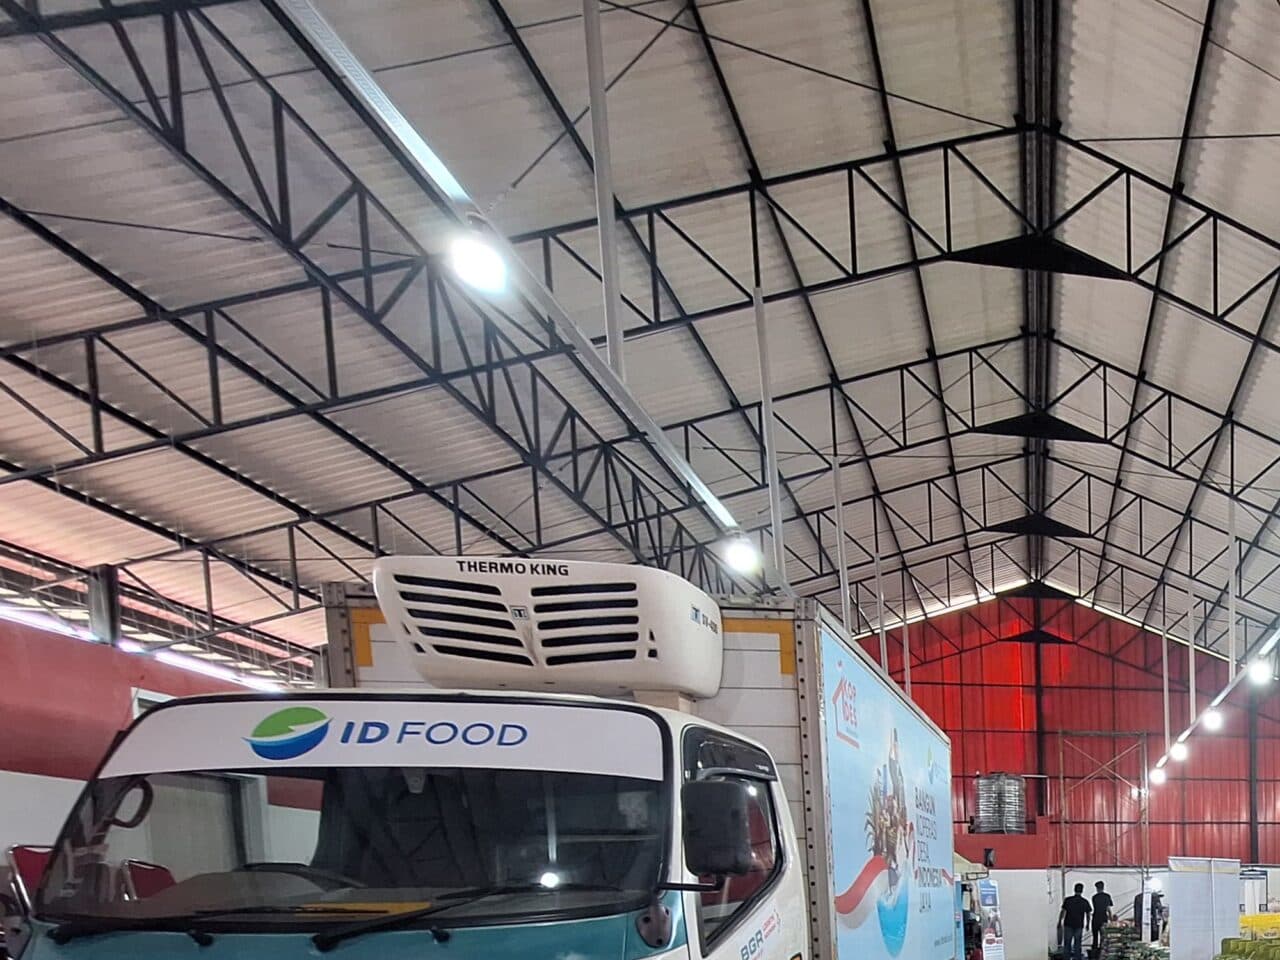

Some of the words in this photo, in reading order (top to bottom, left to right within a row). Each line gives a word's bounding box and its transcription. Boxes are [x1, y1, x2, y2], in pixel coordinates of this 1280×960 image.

[456, 560, 526, 575] THERMO
[530, 561, 569, 576] KING
[340, 721, 390, 744] ID
[396, 721, 528, 746] FOOD
